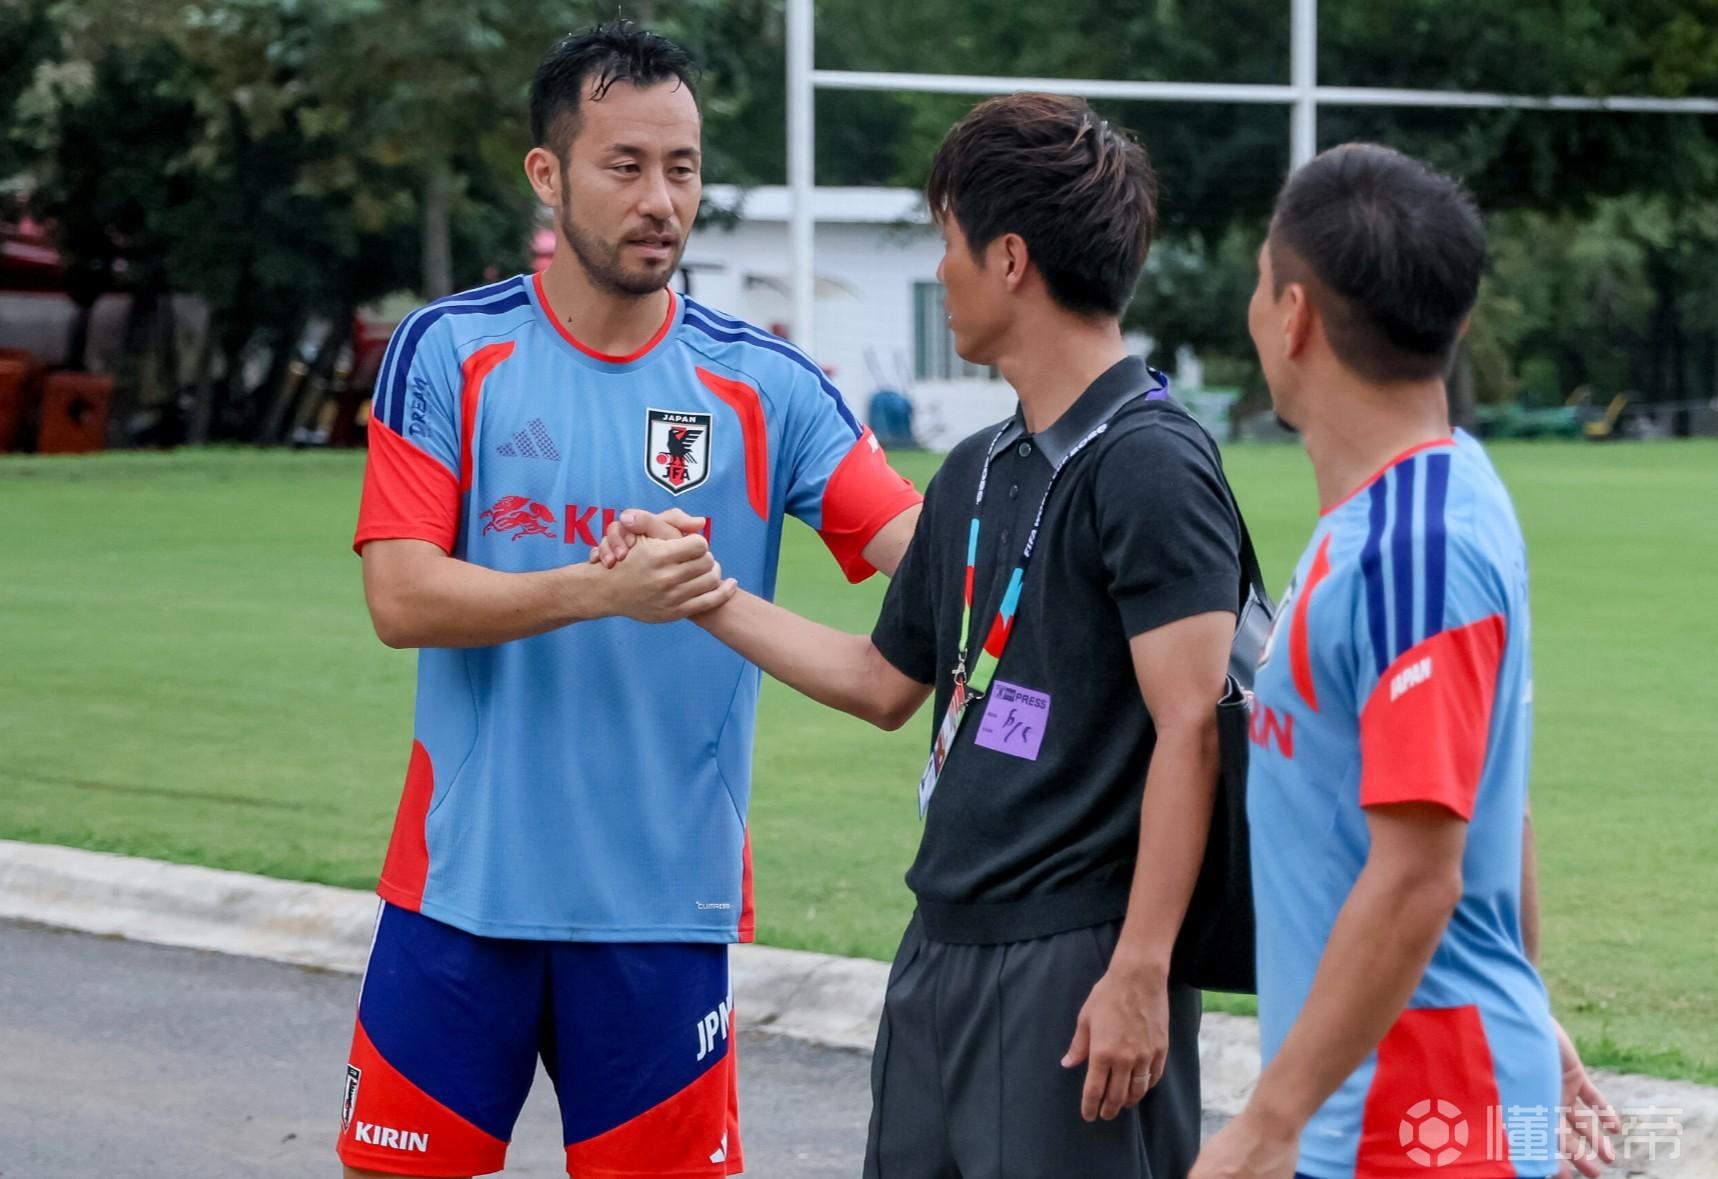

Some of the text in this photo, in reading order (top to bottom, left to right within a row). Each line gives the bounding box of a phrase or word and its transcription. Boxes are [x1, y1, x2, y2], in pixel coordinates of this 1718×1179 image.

[408, 377, 428, 438] DREAM
[662, 414, 697, 424] JAPAN
[662, 466, 690, 481] JFA
[1023, 529, 1037, 558] FIFA
[1016, 692, 1047, 709] PRESS
[355, 1121, 429, 1153] KIRIN
